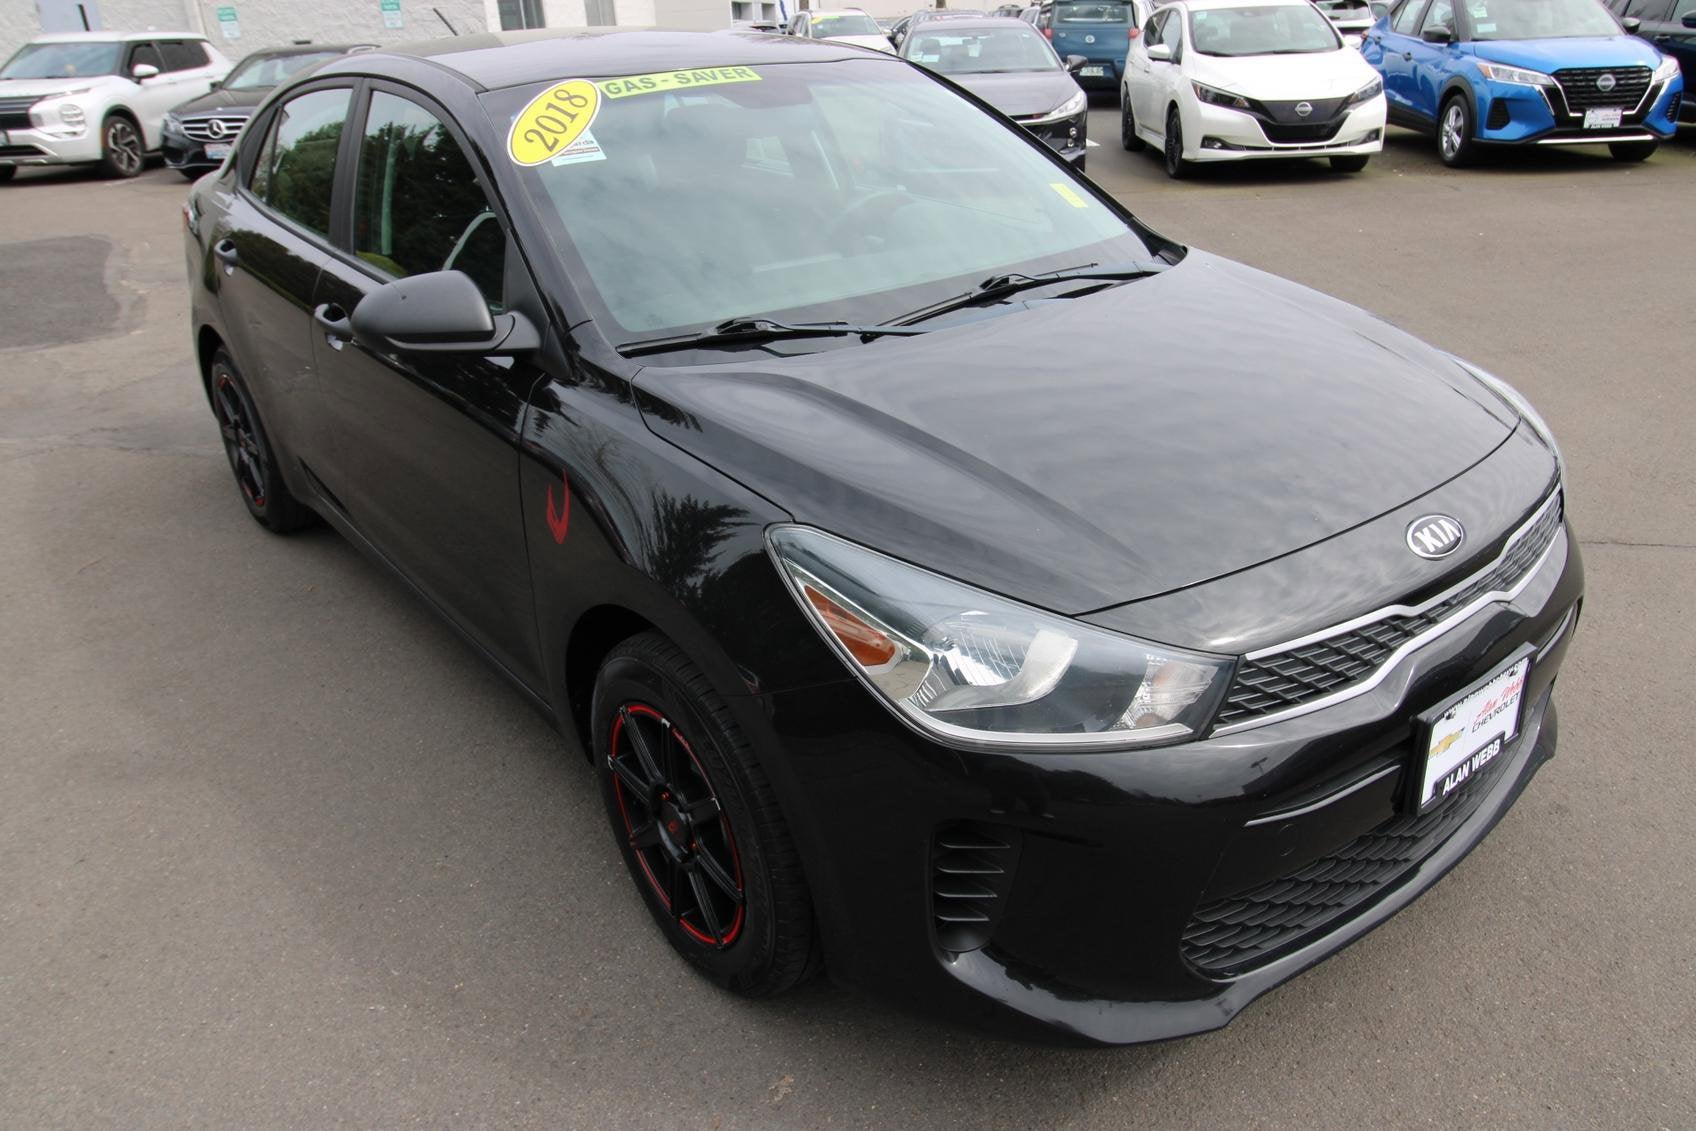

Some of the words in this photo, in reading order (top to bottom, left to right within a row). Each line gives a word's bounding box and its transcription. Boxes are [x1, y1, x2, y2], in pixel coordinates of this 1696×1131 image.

[523, 89, 588, 152] 2018
[1414, 520, 1460, 552] KIA
[1471, 692, 1521, 733] CHEVROLET
[1442, 760, 1471, 796] ALAN
[1472, 739, 1501, 772] WEBB
